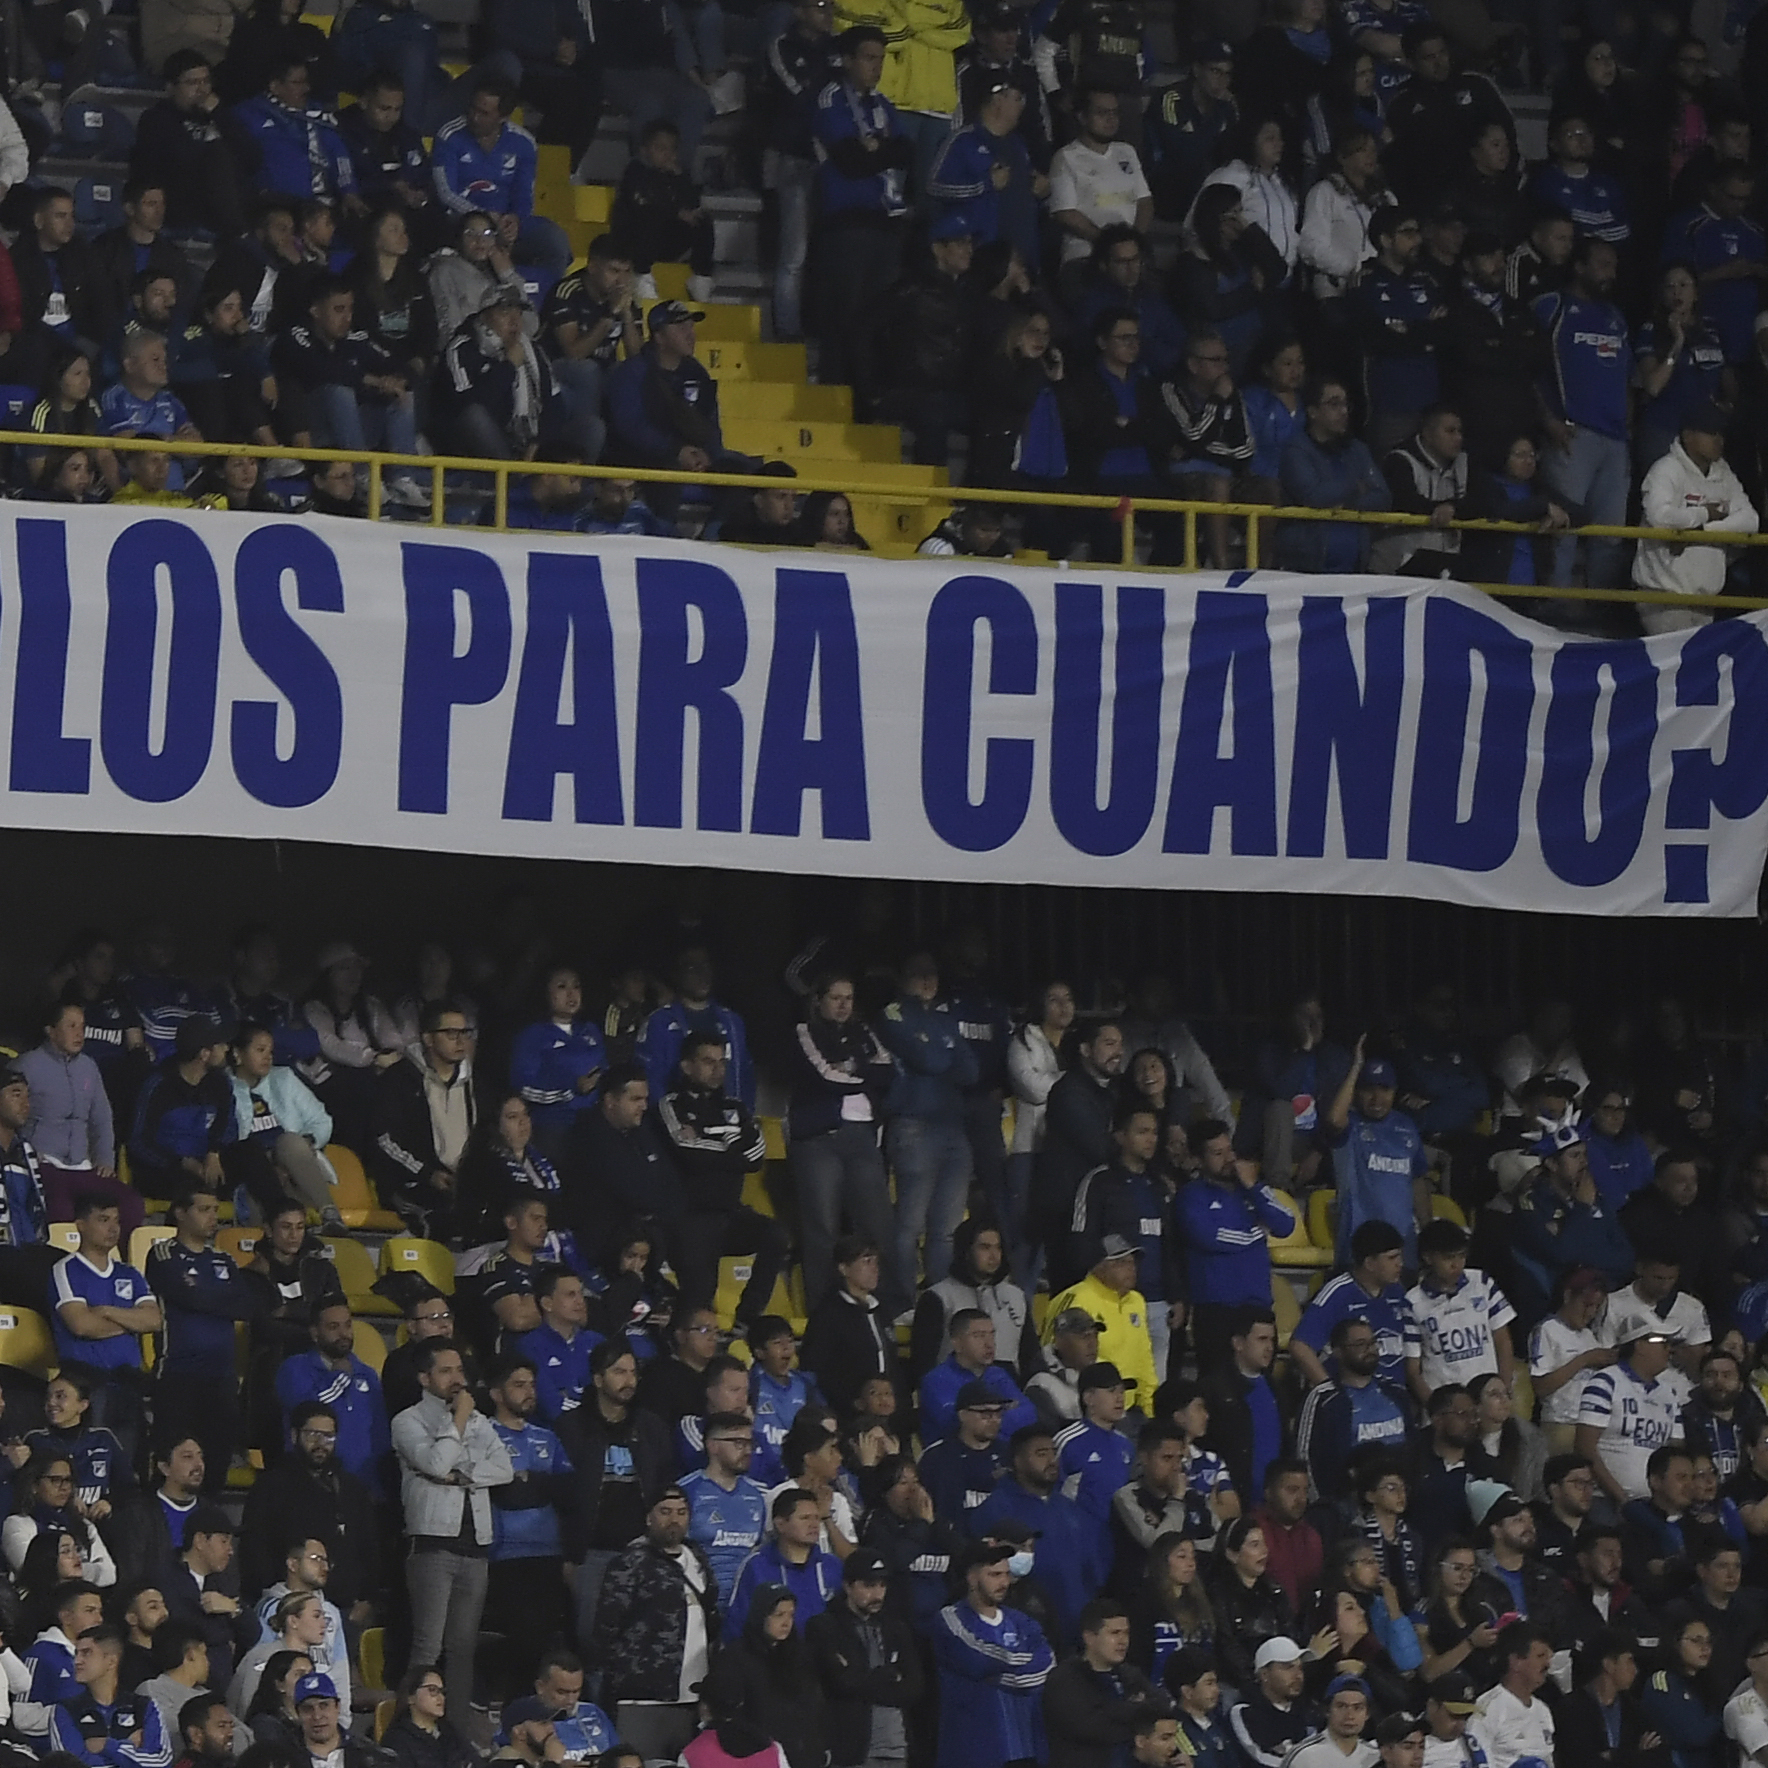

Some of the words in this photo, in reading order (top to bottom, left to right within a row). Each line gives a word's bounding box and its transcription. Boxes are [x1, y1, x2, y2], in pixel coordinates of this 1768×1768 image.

[399, 541, 871, 841] PARA
[921, 571, 1768, 903] CUÁNDO?
[85, 1026, 122, 1044] NDINA
[1622, 1398, 1638, 1414] 10
